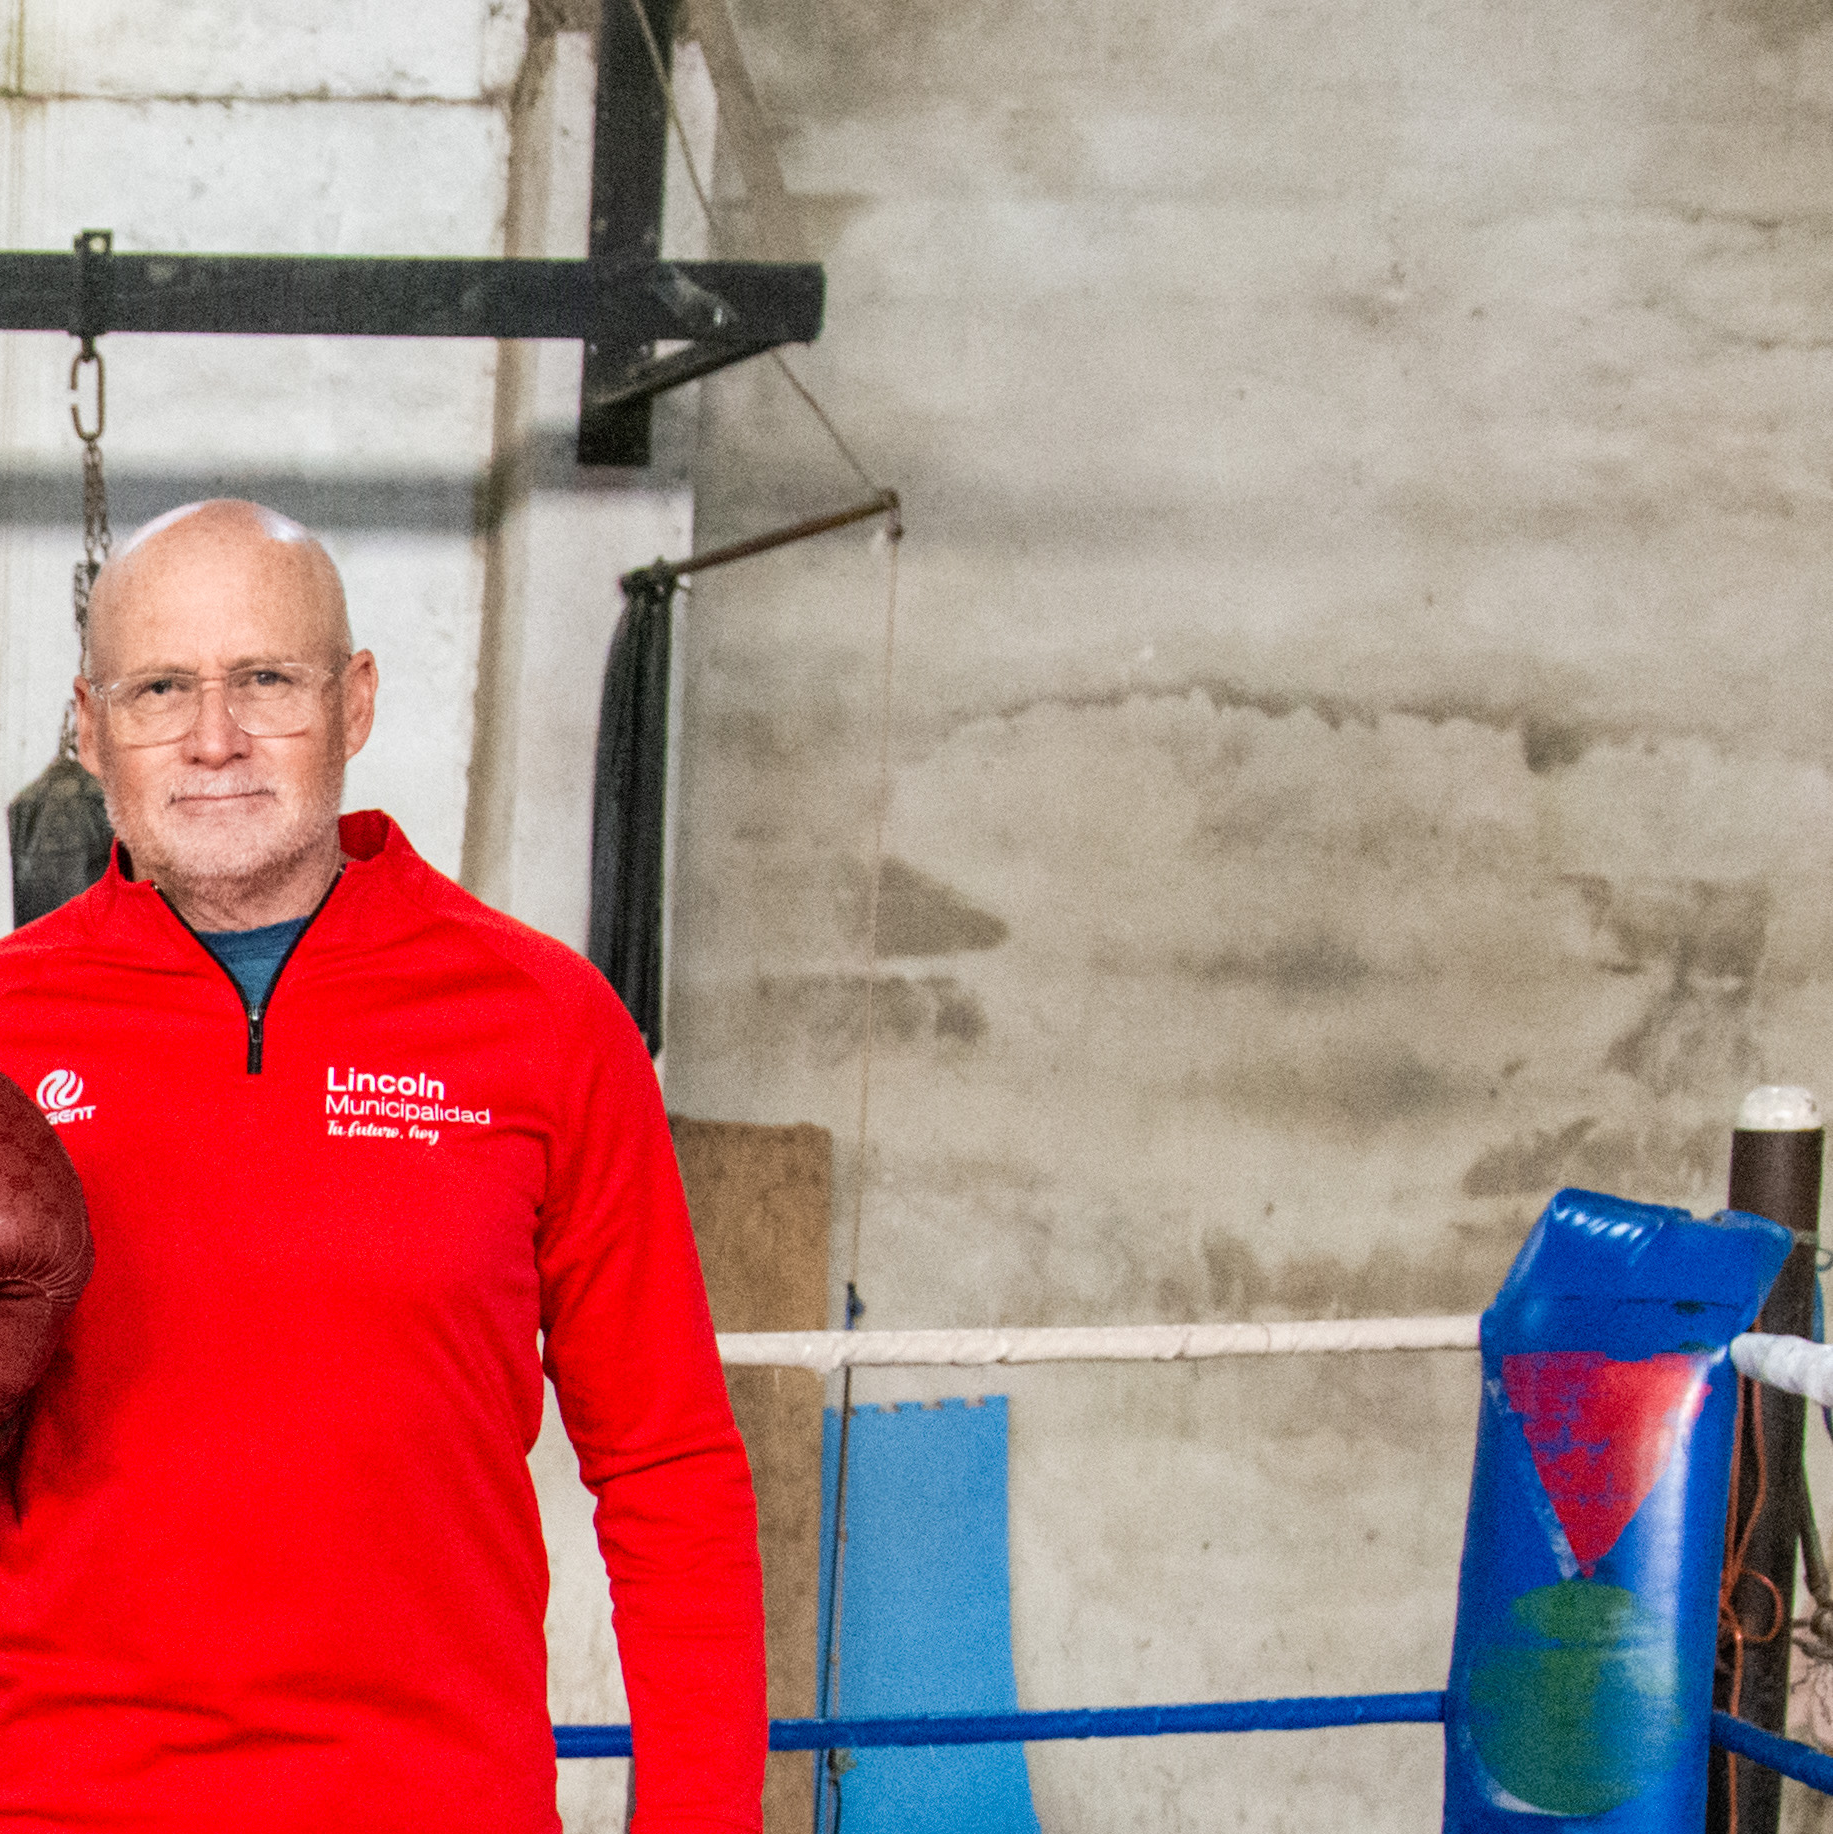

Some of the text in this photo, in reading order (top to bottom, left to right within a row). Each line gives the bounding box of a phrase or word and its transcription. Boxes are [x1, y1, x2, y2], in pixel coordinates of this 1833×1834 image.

[327, 1067, 445, 1101] Lincoln
[326, 1094, 491, 1124] Municipalidad
[408, 1124, 440, 1146] hoy
